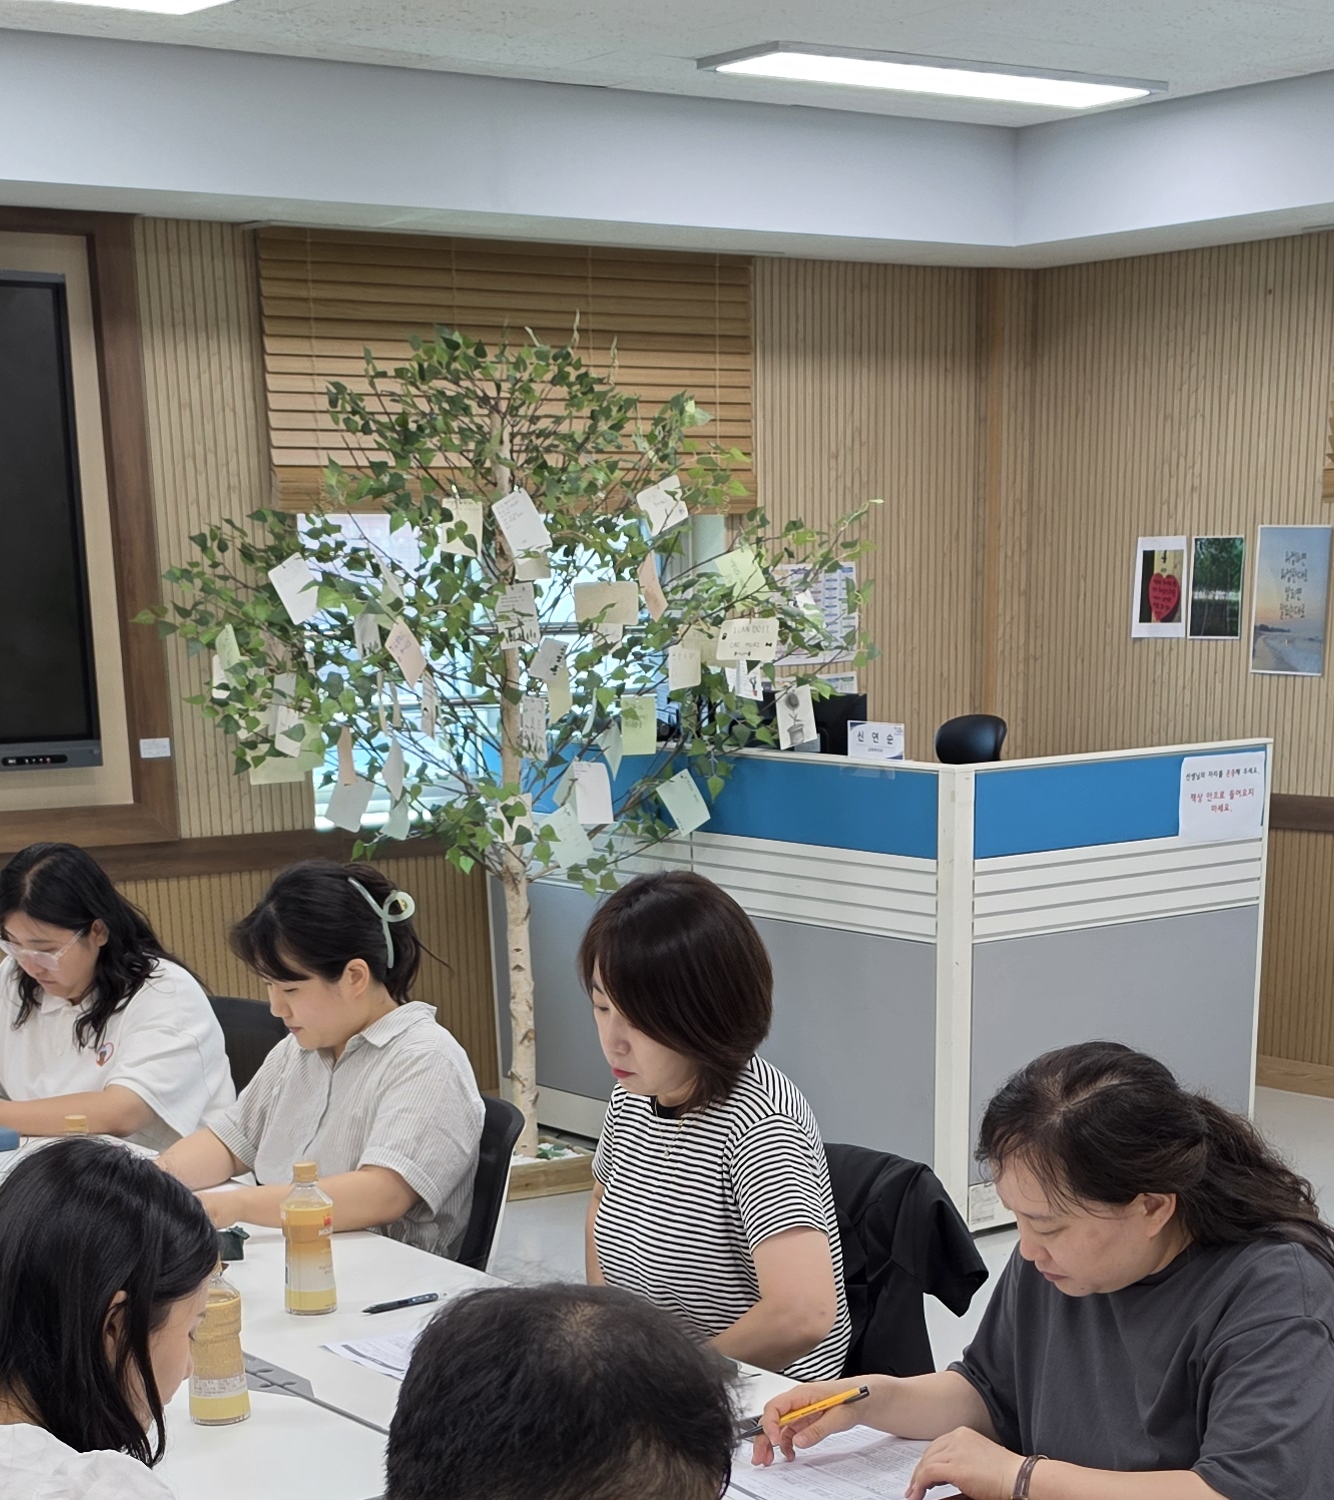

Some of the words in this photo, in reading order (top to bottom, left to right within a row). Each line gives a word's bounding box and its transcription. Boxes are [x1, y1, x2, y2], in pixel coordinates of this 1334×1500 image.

[1208, 769, 1223, 778] 자리를
[1190, 792, 1203, 803] 책상
[1206, 790, 1225, 802] 안으로
[1229, 788, 1255, 800] 들어오지
[1211, 803, 1233, 813] 마세요.
